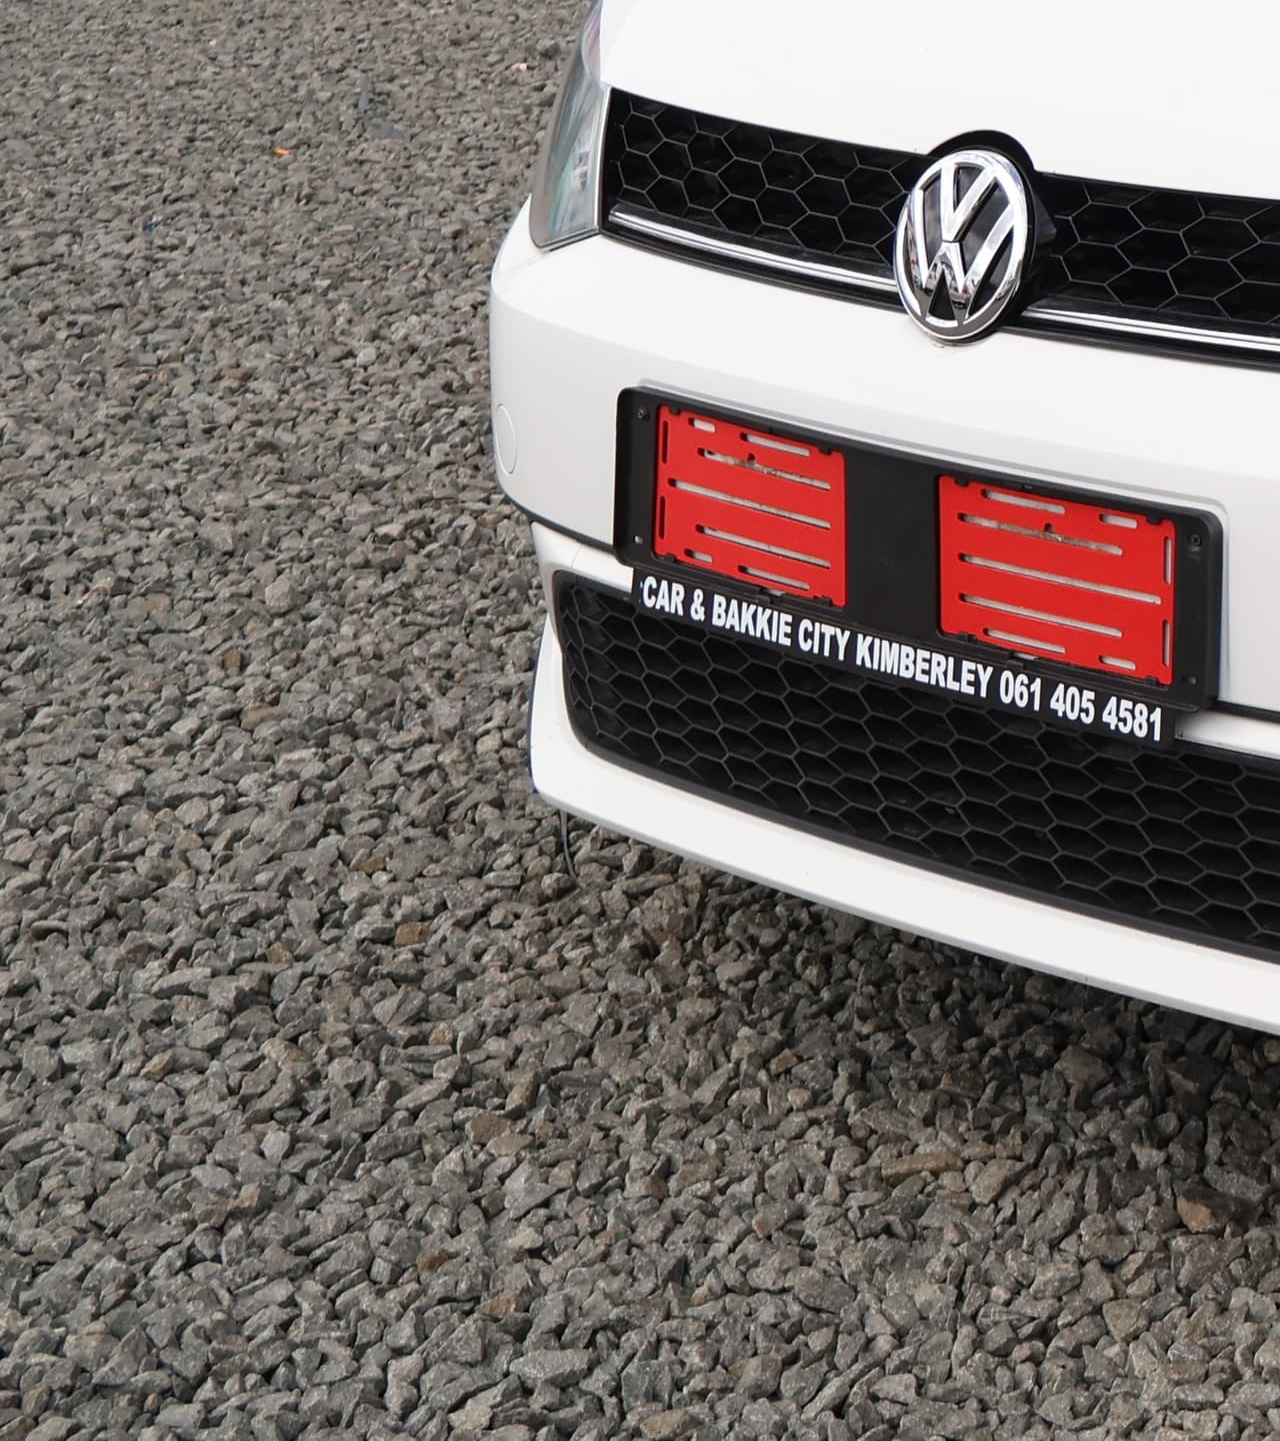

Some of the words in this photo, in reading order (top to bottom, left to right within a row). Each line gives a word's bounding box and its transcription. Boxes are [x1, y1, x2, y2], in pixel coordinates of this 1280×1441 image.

[642, 576, 685, 616] CAR
[690, 588, 705, 621] &
[712, 594, 793, 646] BAKKIE
[798, 618, 850, 661] CITY
[856, 632, 993, 698] KIMBERLEY
[999, 670, 1041, 711] 061
[1050, 683, 1095, 724] 405
[1102, 696, 1161, 741] 4581
